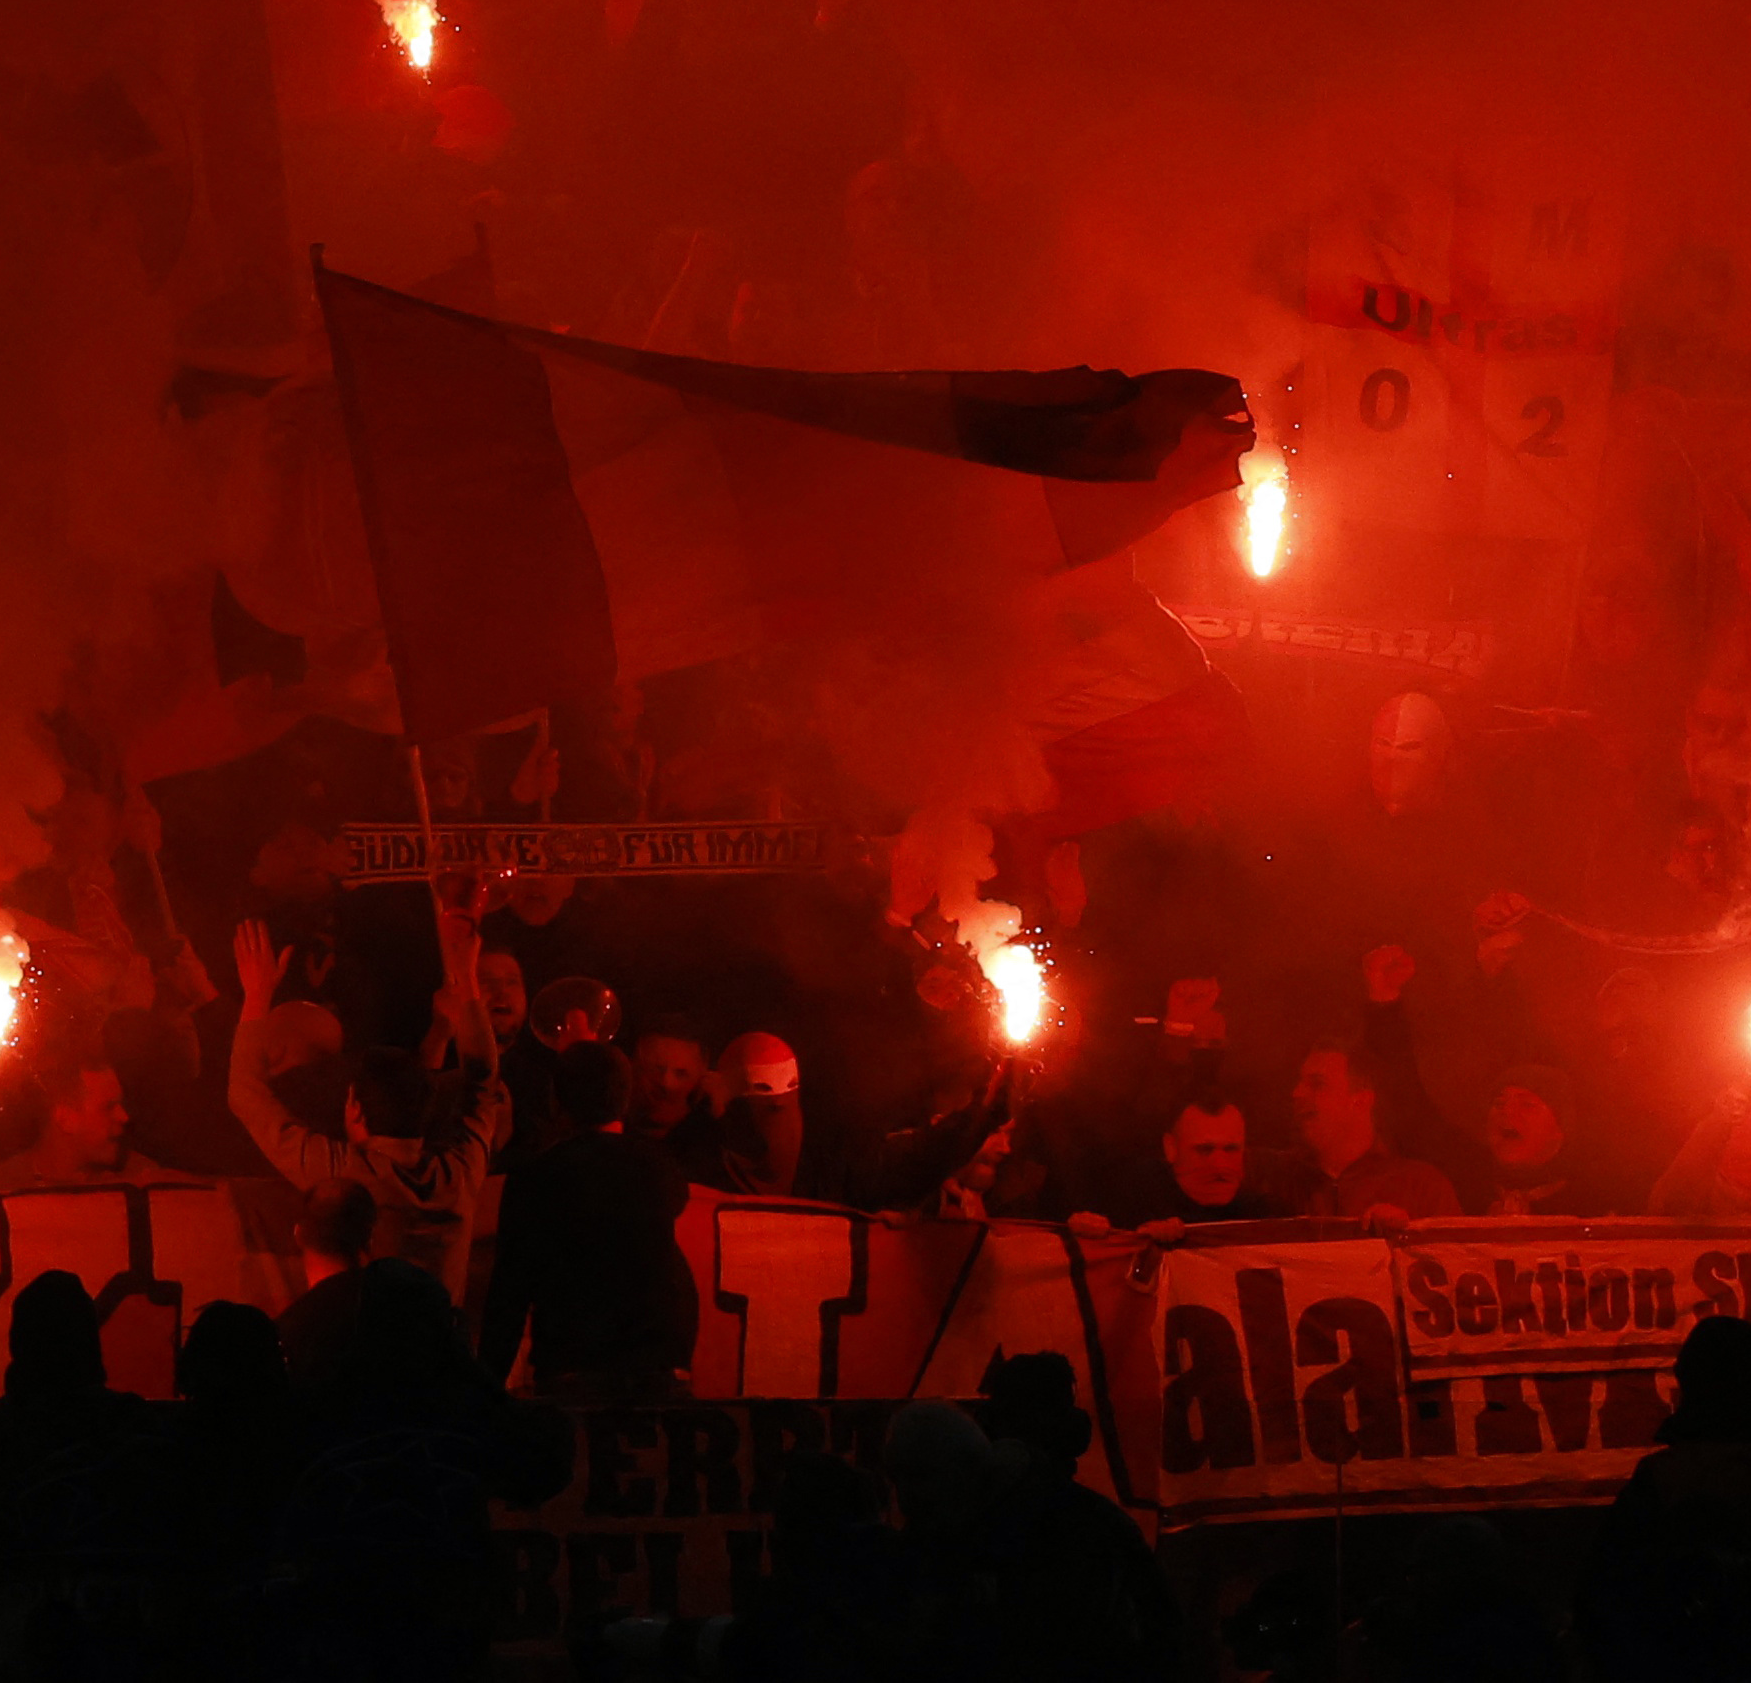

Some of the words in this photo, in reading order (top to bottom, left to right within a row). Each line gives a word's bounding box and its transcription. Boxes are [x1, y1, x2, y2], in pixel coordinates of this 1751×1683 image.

[1362, 284, 1577, 353] Ultras
[1518, 394, 1568, 457] 2
[624, 832, 698, 865] FÜR
[1404, 1255, 1682, 1341] Sektion
